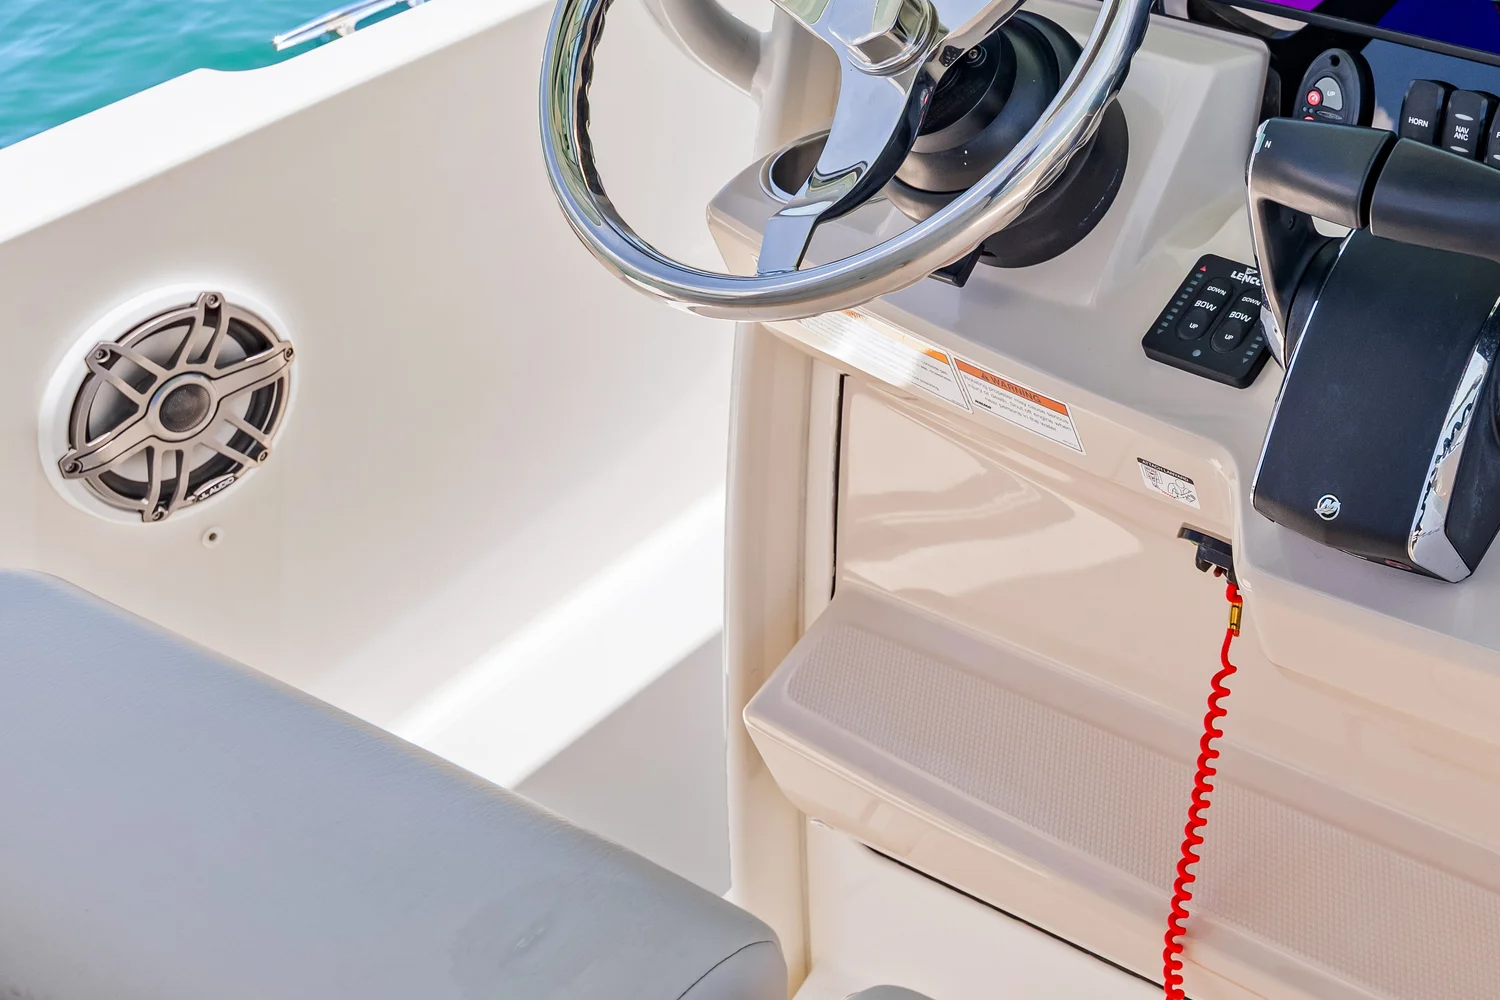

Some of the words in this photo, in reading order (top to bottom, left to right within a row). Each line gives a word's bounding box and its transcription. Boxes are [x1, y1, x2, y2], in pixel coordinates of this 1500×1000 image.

[1408, 116, 1429, 128] HORN
[1455, 126, 1470, 134] NAV
[1454, 131, 1469, 141] ANC
[1264, 140, 1271, 148] N
[1207, 286, 1226, 296] DOWN
[1194, 300, 1217, 312] BOW
[1241, 296, 1261, 306] DOWN
[1229, 311, 1252, 322] BOW
[990, 376, 1041, 403] WARNING
